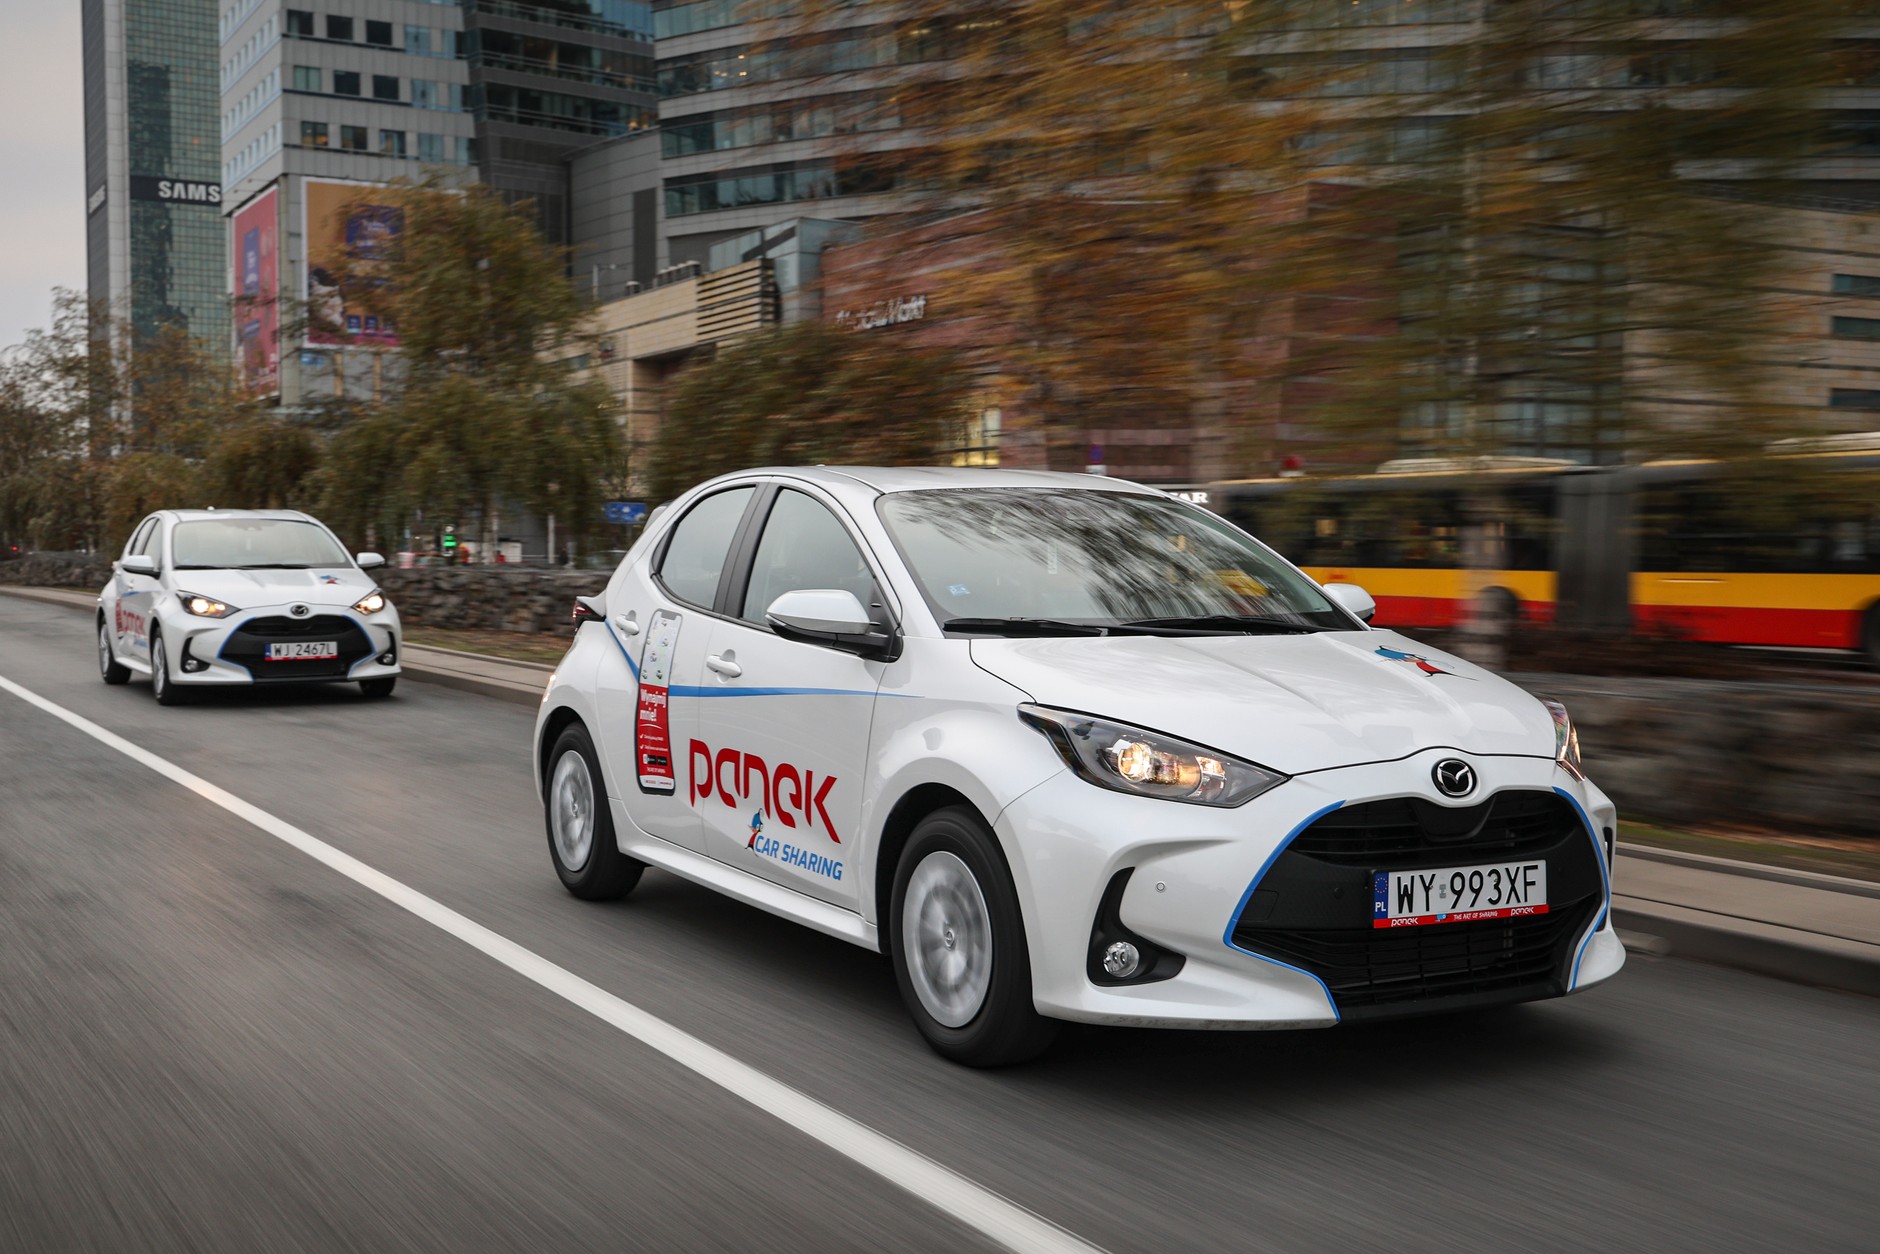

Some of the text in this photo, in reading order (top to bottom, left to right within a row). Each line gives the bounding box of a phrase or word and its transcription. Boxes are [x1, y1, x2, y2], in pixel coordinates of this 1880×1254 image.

[158, 181, 220, 202] SAMS
[274, 643, 334, 656] WJ 2467L
[689, 738, 842, 844] panek
[755, 835, 843, 881] CAR SHARING
[1397, 864, 1538, 914] WY 993XF
[1375, 902, 1386, 912] PL
